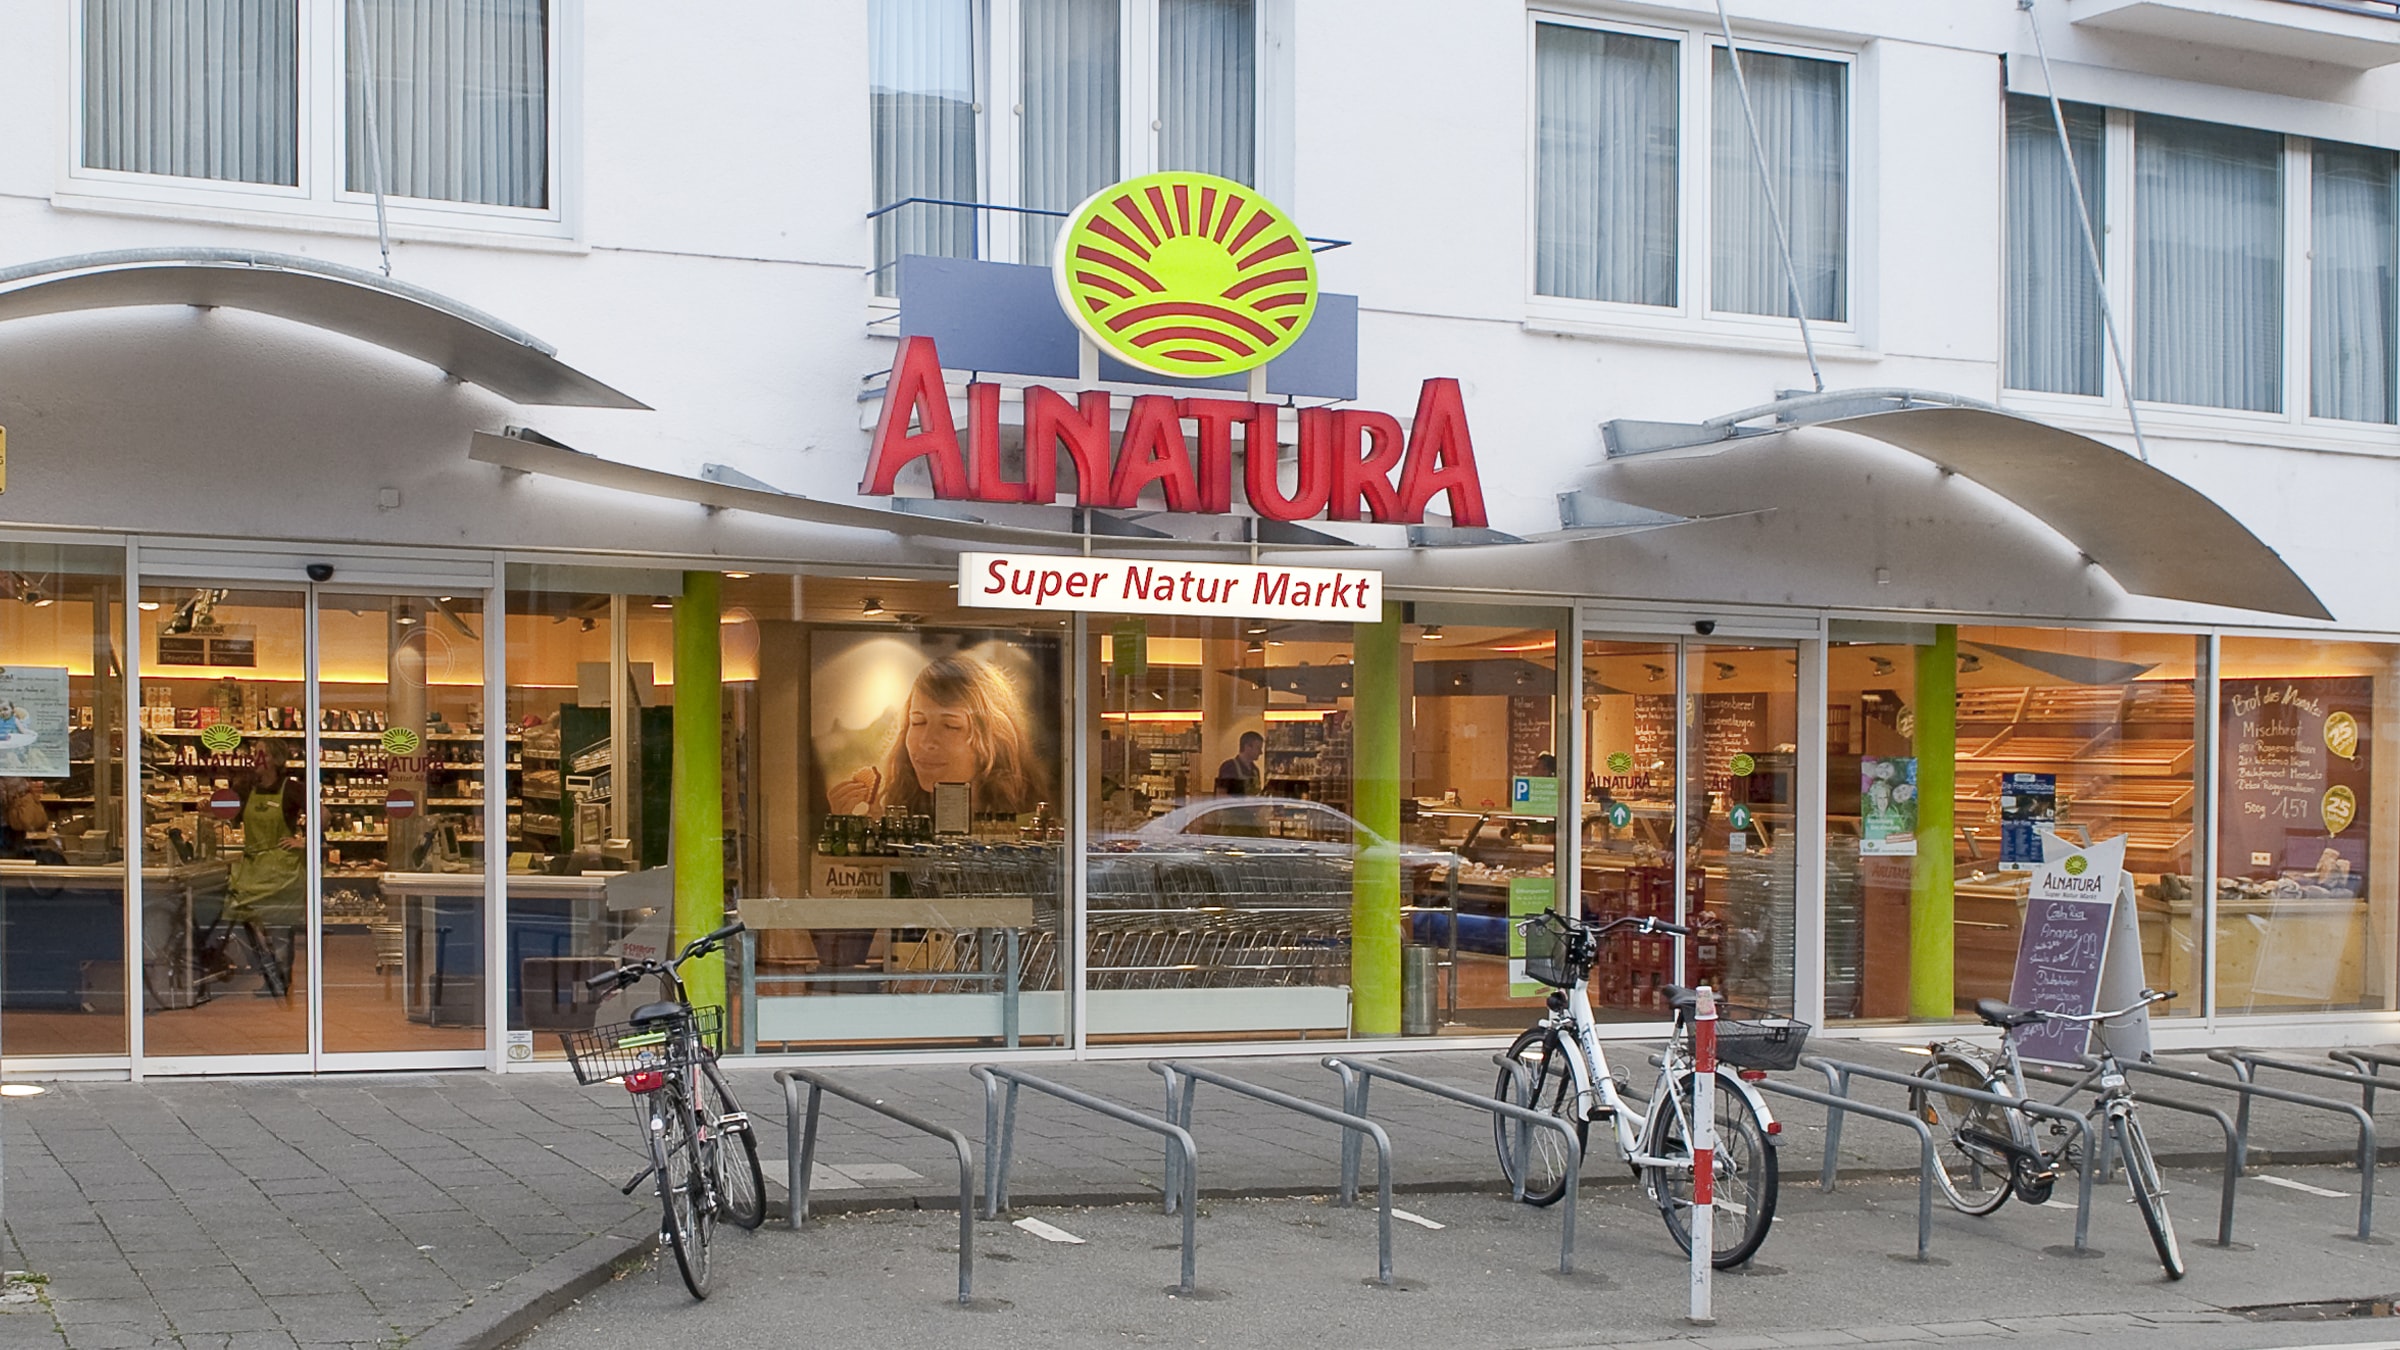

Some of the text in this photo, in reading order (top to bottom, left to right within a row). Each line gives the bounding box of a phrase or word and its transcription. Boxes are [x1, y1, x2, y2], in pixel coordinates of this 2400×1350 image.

[858, 334, 1488, 528] ALNATURA
[984, 560, 1370, 610] Super Natur Markt
[2232, 685, 2261, 717] Brot
[2243, 720, 2302, 738] Mischbrot
[1516, 781, 1528, 800] P
[1586, 771, 1651, 790] ALNATURA
[2326, 797, 2351, 817] 25
[2043, 872, 2101, 892] ALNATURA
